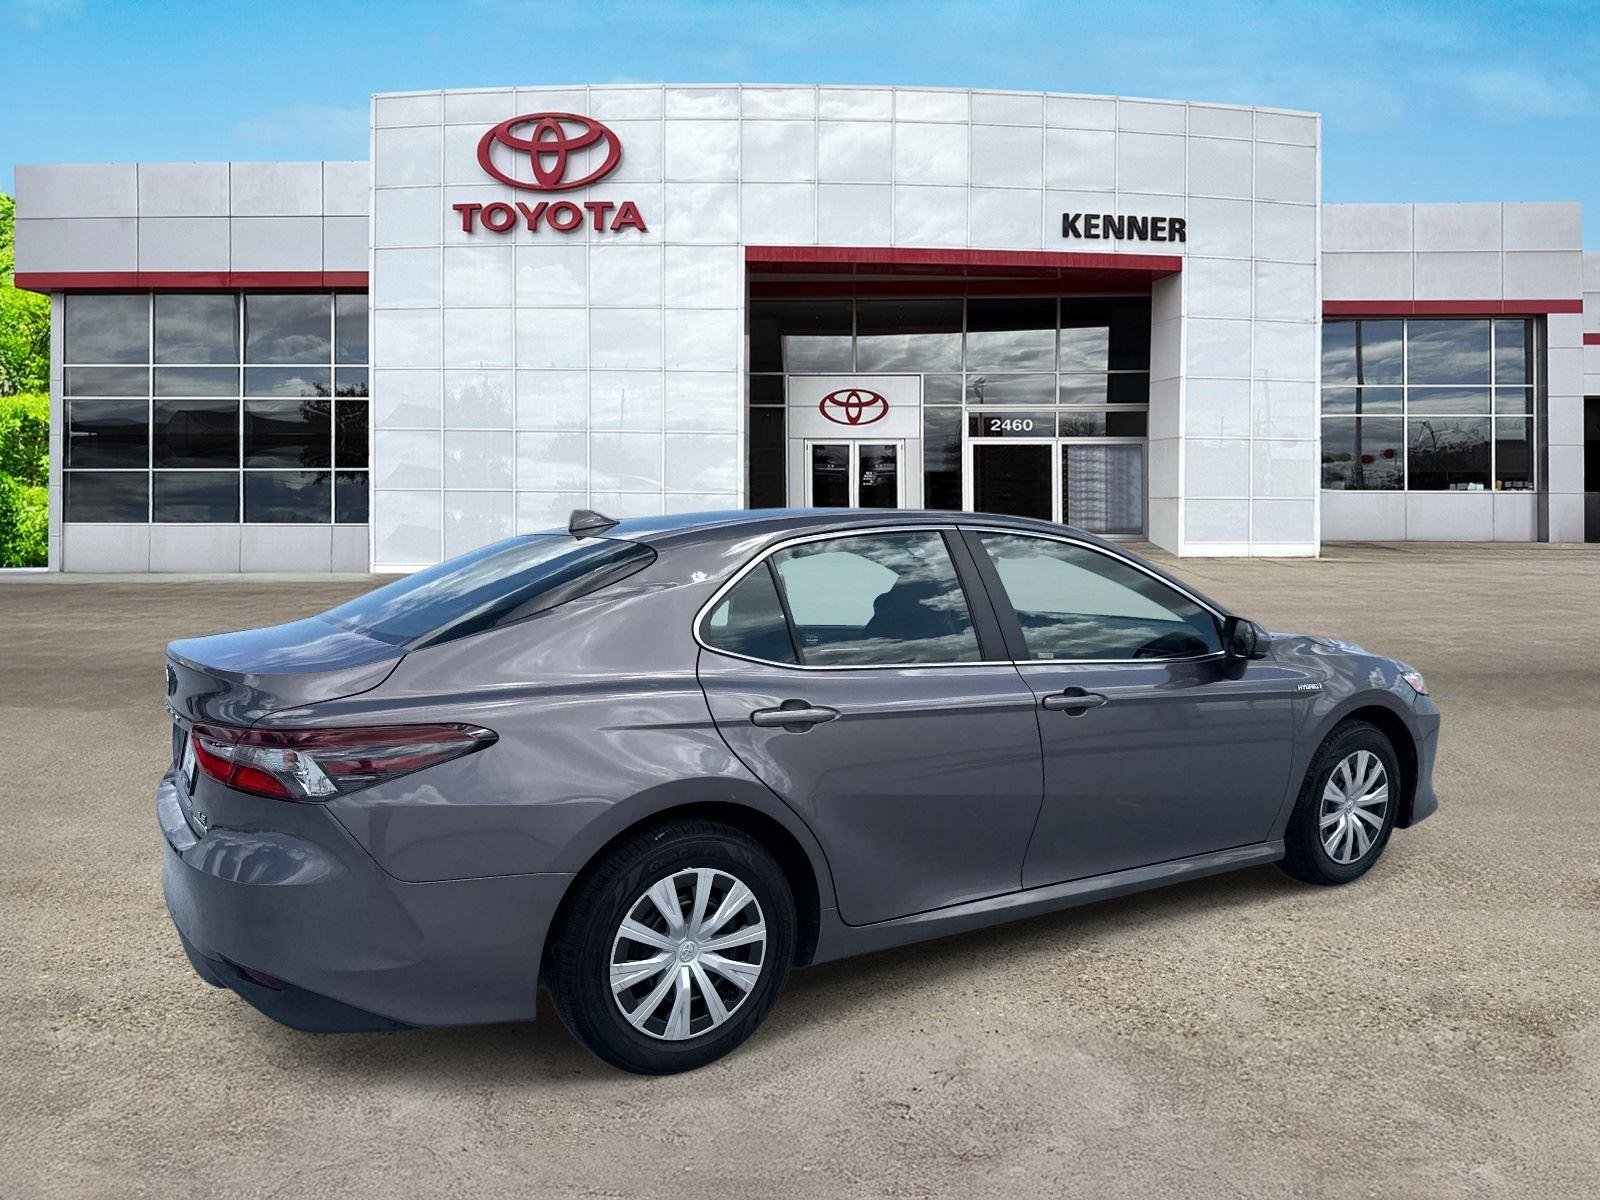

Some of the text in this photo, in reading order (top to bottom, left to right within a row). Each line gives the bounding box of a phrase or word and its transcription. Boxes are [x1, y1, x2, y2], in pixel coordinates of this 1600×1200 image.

[453, 201, 647, 233] TOYOTA
[1062, 213, 1187, 242] KENNER
[990, 419, 1033, 431] 2460
